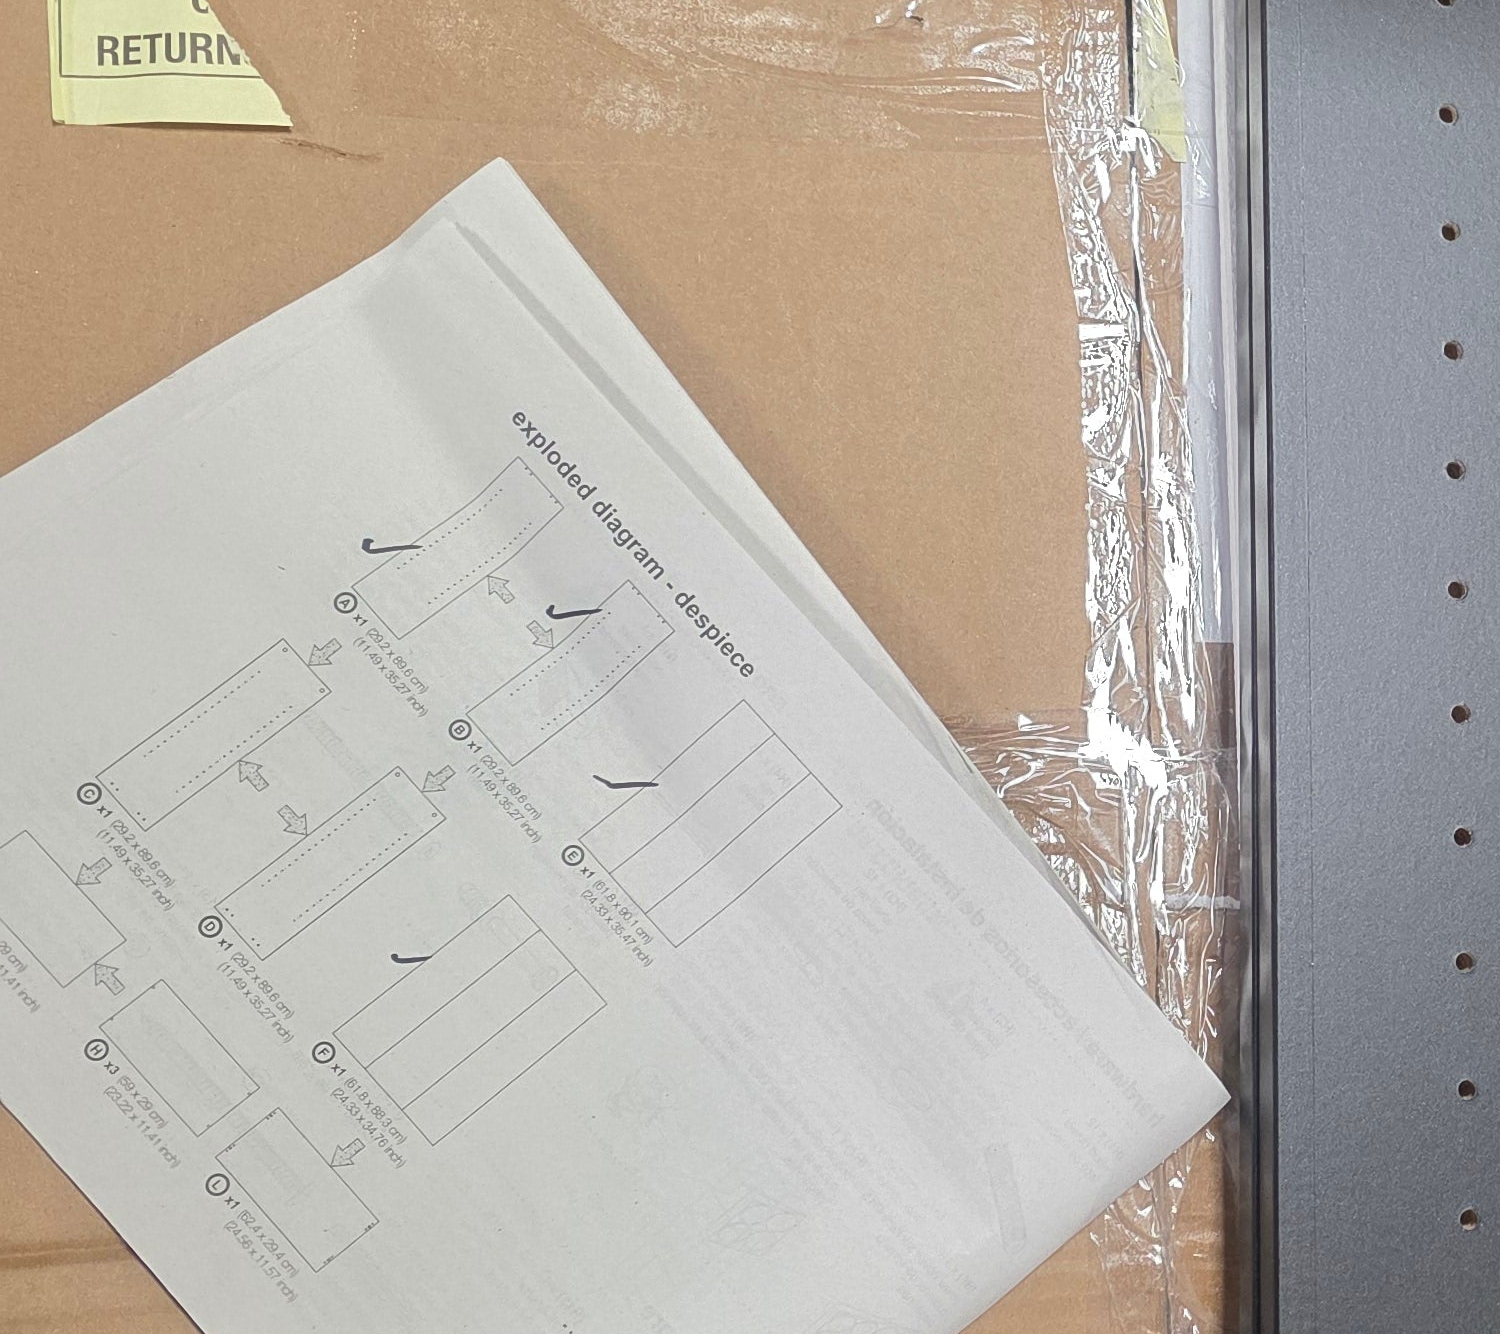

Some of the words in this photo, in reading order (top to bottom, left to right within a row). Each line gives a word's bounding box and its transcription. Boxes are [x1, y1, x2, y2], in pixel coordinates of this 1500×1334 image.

[97, 32, 251, 66] RETURN
[511, 411, 597, 500] exploded
[591, 501, 664, 580] diagram
[674, 592, 754, 677] despiece
[352, 613, 368, 626] x1
[466, 740, 482, 753] x1
[96, 805, 113, 818] x1
[579, 866, 595, 878] x1
[217, 938, 233, 951] x1
[103, 1060, 119, 1074] x3
[330, 1063, 346, 1076] x1
[223, 1195, 240, 1209] x1
